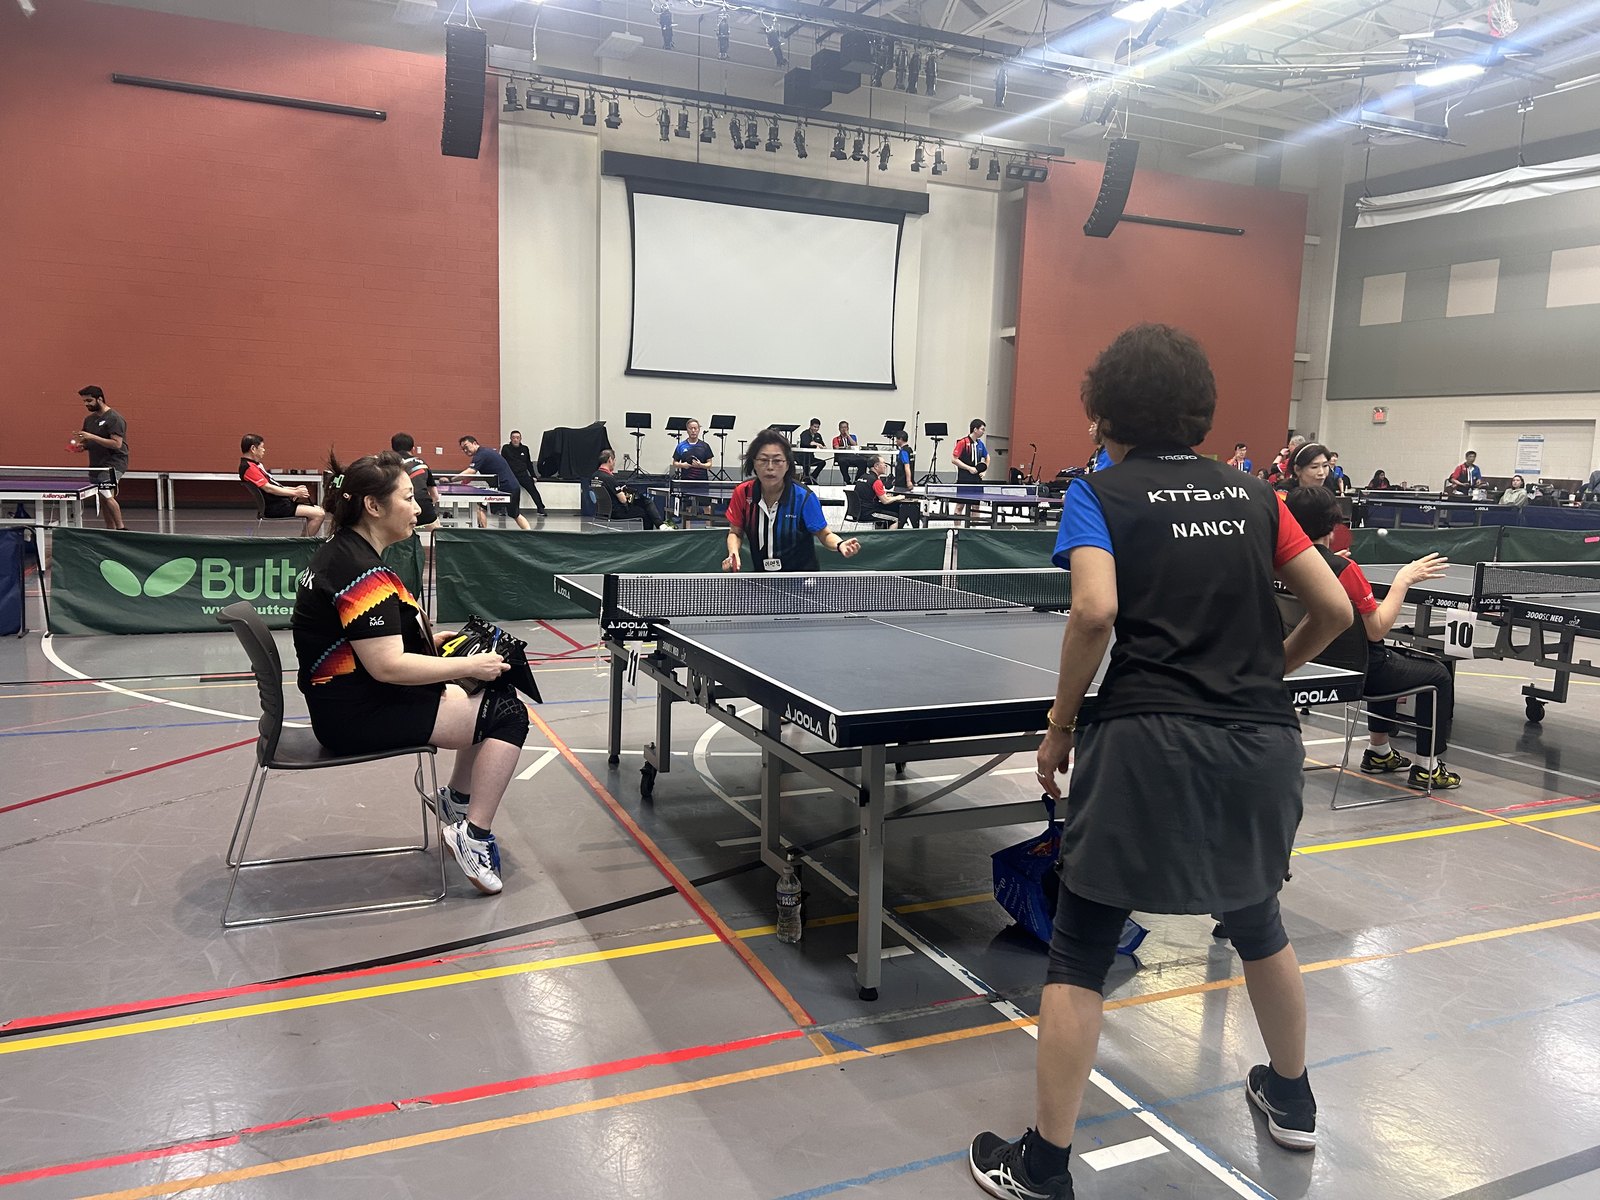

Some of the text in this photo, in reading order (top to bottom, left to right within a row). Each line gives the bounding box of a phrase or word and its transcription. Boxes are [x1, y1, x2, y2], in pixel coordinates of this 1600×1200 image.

[1212, 490, 1225, 500] of
[1224, 486, 1250, 501] VA
[1171, 519, 1246, 539] NANCY
[202, 558, 301, 600] Butt
[615, 621, 649, 629] JOOLA
[1525, 610, 1564, 623] 3000SC NEO
[1447, 620, 1474, 649] 10
[441, 634, 469, 657] 4
[1292, 689, 1339, 705] JOOLA
[791, 708, 823, 737] JOOLA
[828, 713, 838, 744] 6
